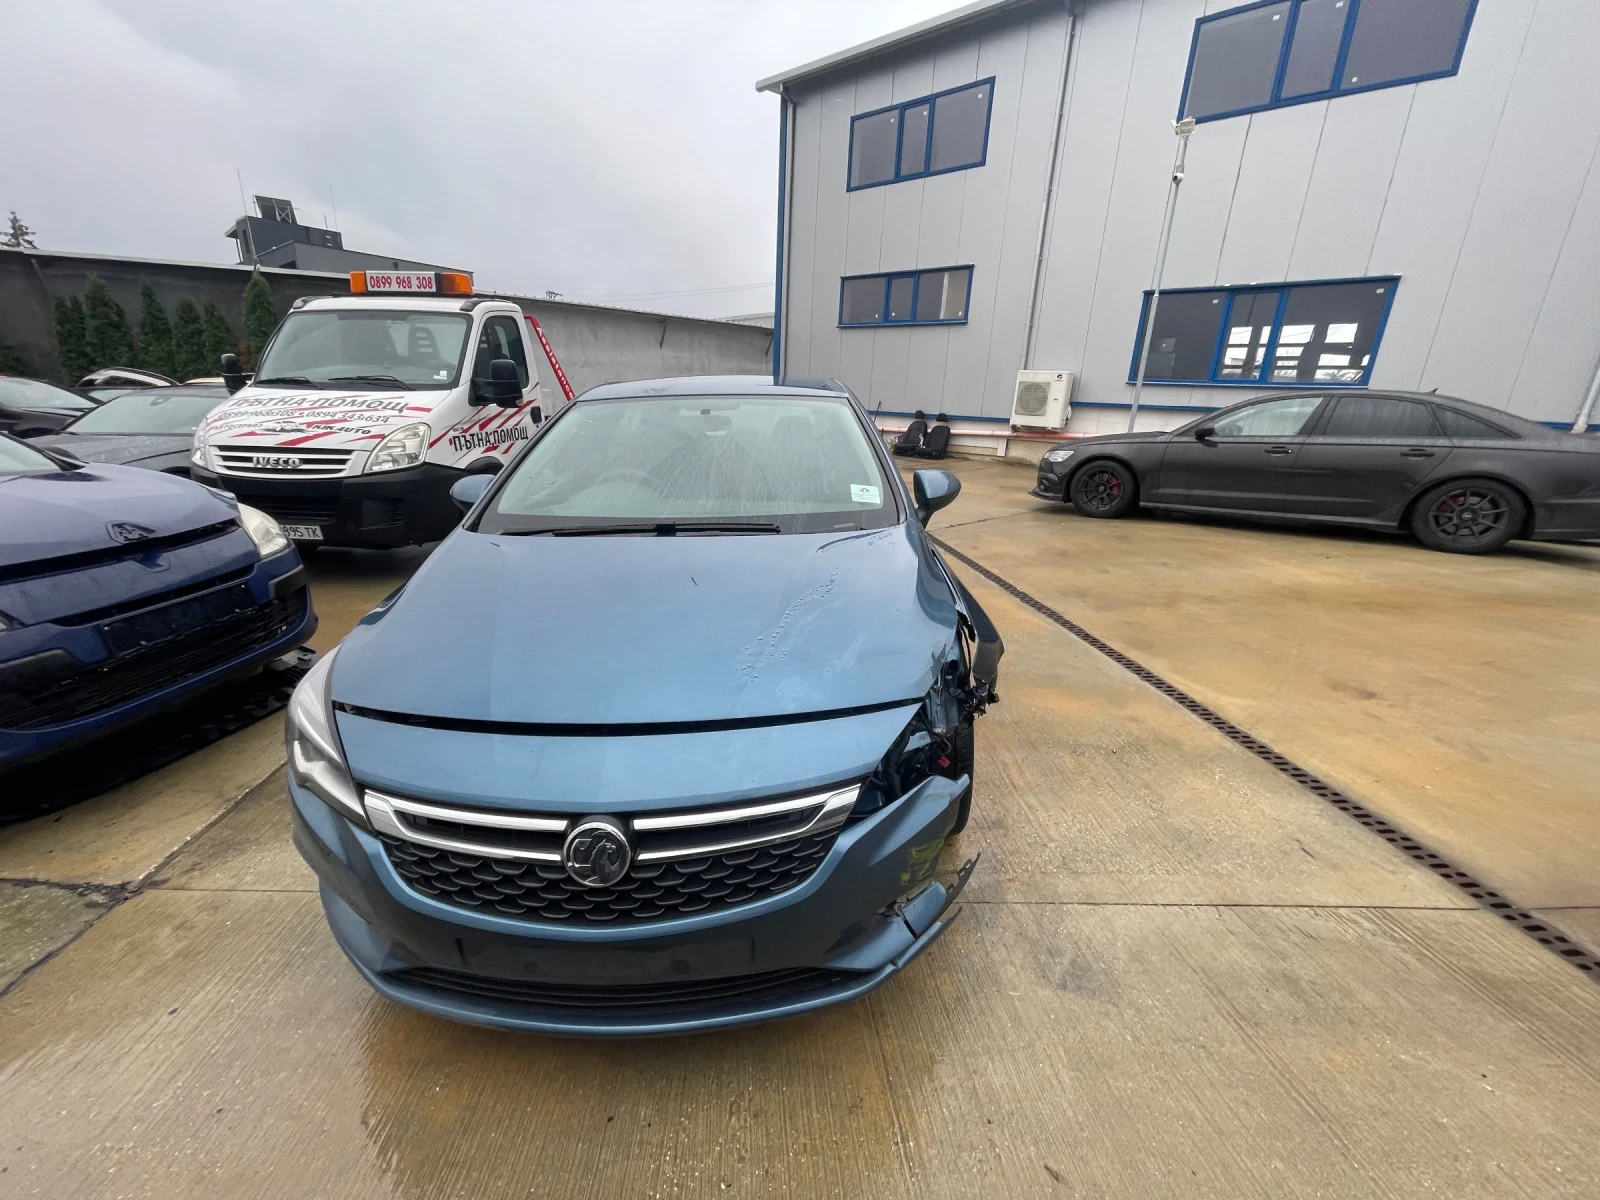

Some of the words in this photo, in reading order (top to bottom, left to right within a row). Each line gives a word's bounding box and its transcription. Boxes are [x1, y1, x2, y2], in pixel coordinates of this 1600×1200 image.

[369, 276, 392, 289] 0899
[395, 276, 412, 289] 968
[416, 276, 433, 289] 308
[536, 327, 574, 399] Assistance
[309, 398, 408, 413] ПОМОЩ
[452, 432, 491, 452] ПЪТНА
[492, 426, 529, 445] ПОМОЩ
[252, 456, 303, 469] IVECO
